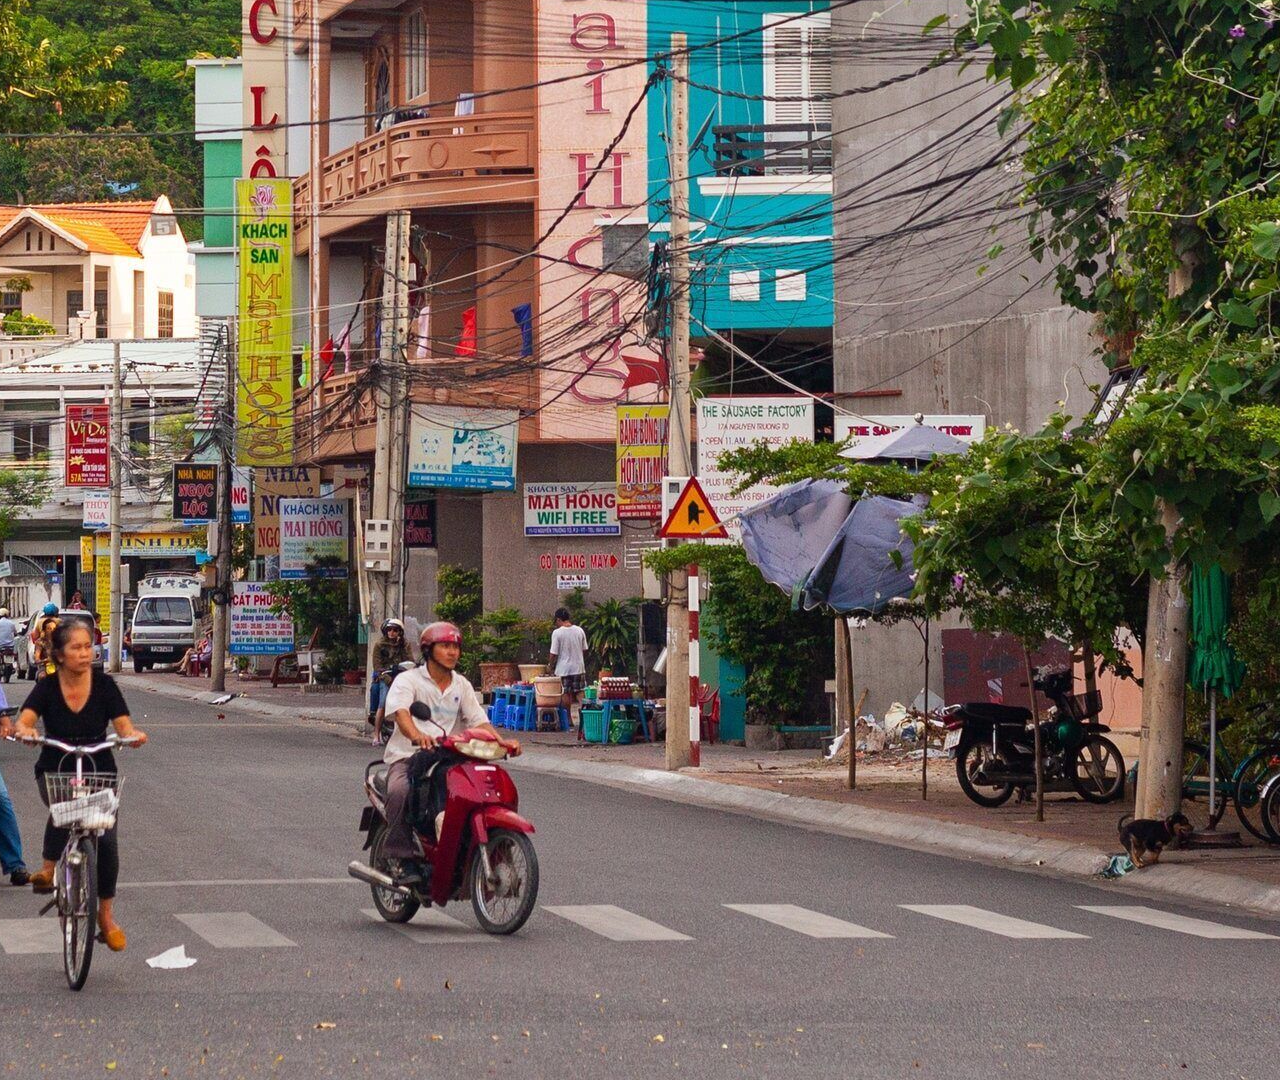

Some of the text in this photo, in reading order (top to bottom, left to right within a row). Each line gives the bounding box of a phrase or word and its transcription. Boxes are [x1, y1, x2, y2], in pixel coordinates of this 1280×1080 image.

[247, 272, 282, 346] Mai
[703, 405, 807, 418] THE SAUSAGE FACTORY
[659, 418, 670, 445] LA
[848, 425, 973, 436] THE ACTORY
[705, 437, 723, 446] OPEN
[705, 477, 721, 486] PLUS
[177, 483, 214, 499] NGỌC
[752, 492, 765, 501] FISH
[283, 502, 343, 517] KHÁCH SẠN
[528, 494, 559, 510] MAI
[87, 510, 106, 520] NGA
[537, 510, 607, 525] WIFI FREE
[284, 516, 342, 537] MAI HỒNG
[556, 554, 586, 569] THANG
[590, 552, 609, 569] MÁY
[233, 592, 251, 605] CÁT
